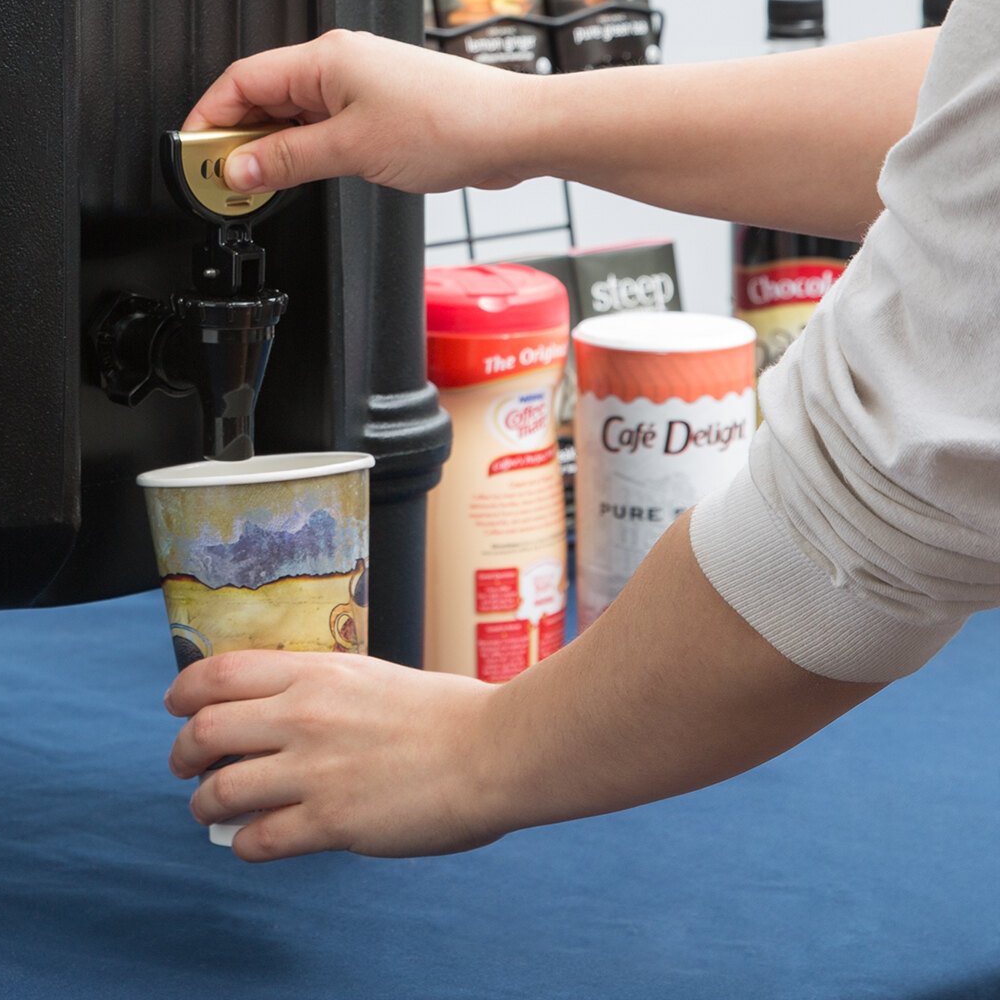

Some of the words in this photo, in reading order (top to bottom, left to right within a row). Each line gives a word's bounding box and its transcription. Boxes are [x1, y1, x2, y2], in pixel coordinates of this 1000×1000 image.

[591, 272, 675, 312] steep
[747, 270, 834, 305] Chocol
[485, 354, 516, 374] The
[602, 415, 657, 453] Café
[664, 420, 747, 455] Delight
[600, 503, 664, 521] PURE
